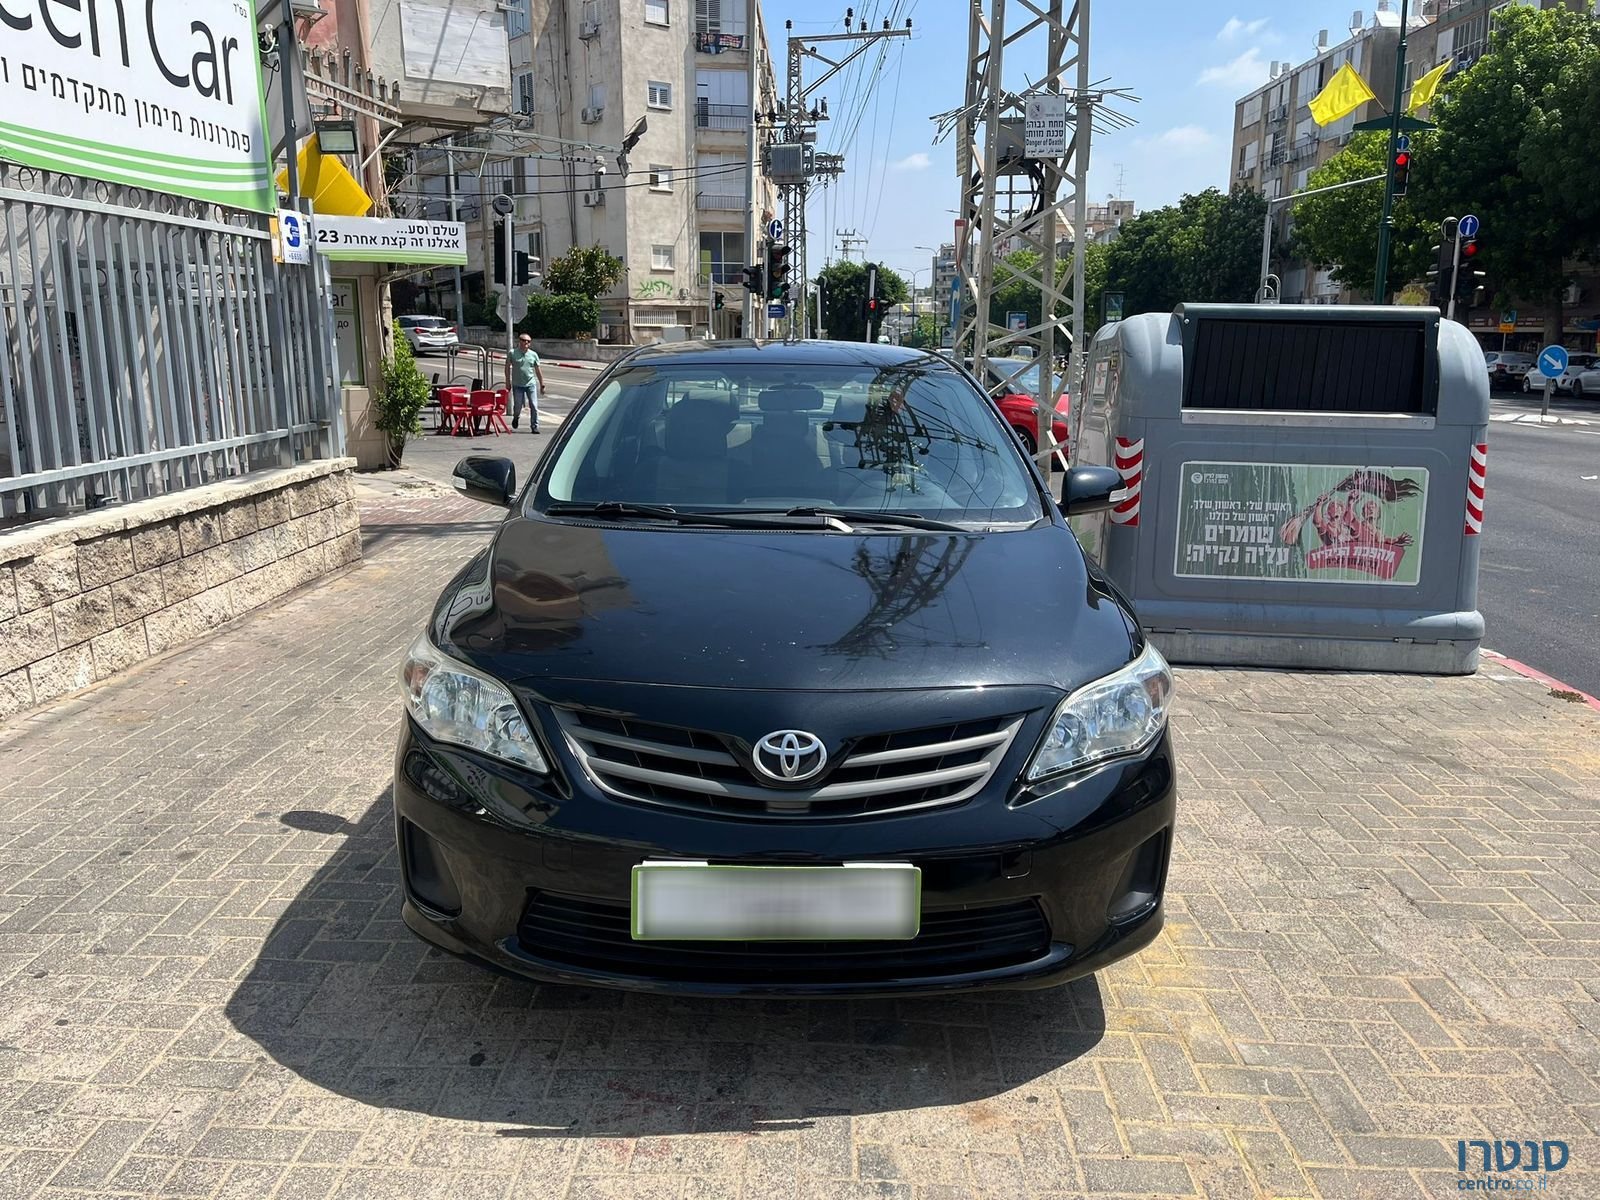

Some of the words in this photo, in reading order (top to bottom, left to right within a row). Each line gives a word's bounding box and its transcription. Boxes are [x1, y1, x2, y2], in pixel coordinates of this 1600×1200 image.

[145, 0, 239, 106] Car
[21, 62, 127, 117] מתקדמים
[134, 98, 182, 133] מימון
[189, 116, 251, 153] פתרונות
[396, 225, 429, 235] וסע...
[433, 224, 459, 236] שלם
[343, 234, 378, 246] אחרת
[381, 236, 406, 248] קצת
[411, 237, 423, 247] זה
[427, 236, 459, 248] אצלנו
[1214, 500, 1241, 511] ראשון
[1232, 511, 1246, 521] של
[1248, 512, 1275, 522] ראשון
[1204, 524, 1275, 543] שומרים
[1186, 543, 1240, 566] נקייה!
[1244, 544, 1290, 566] עליה
